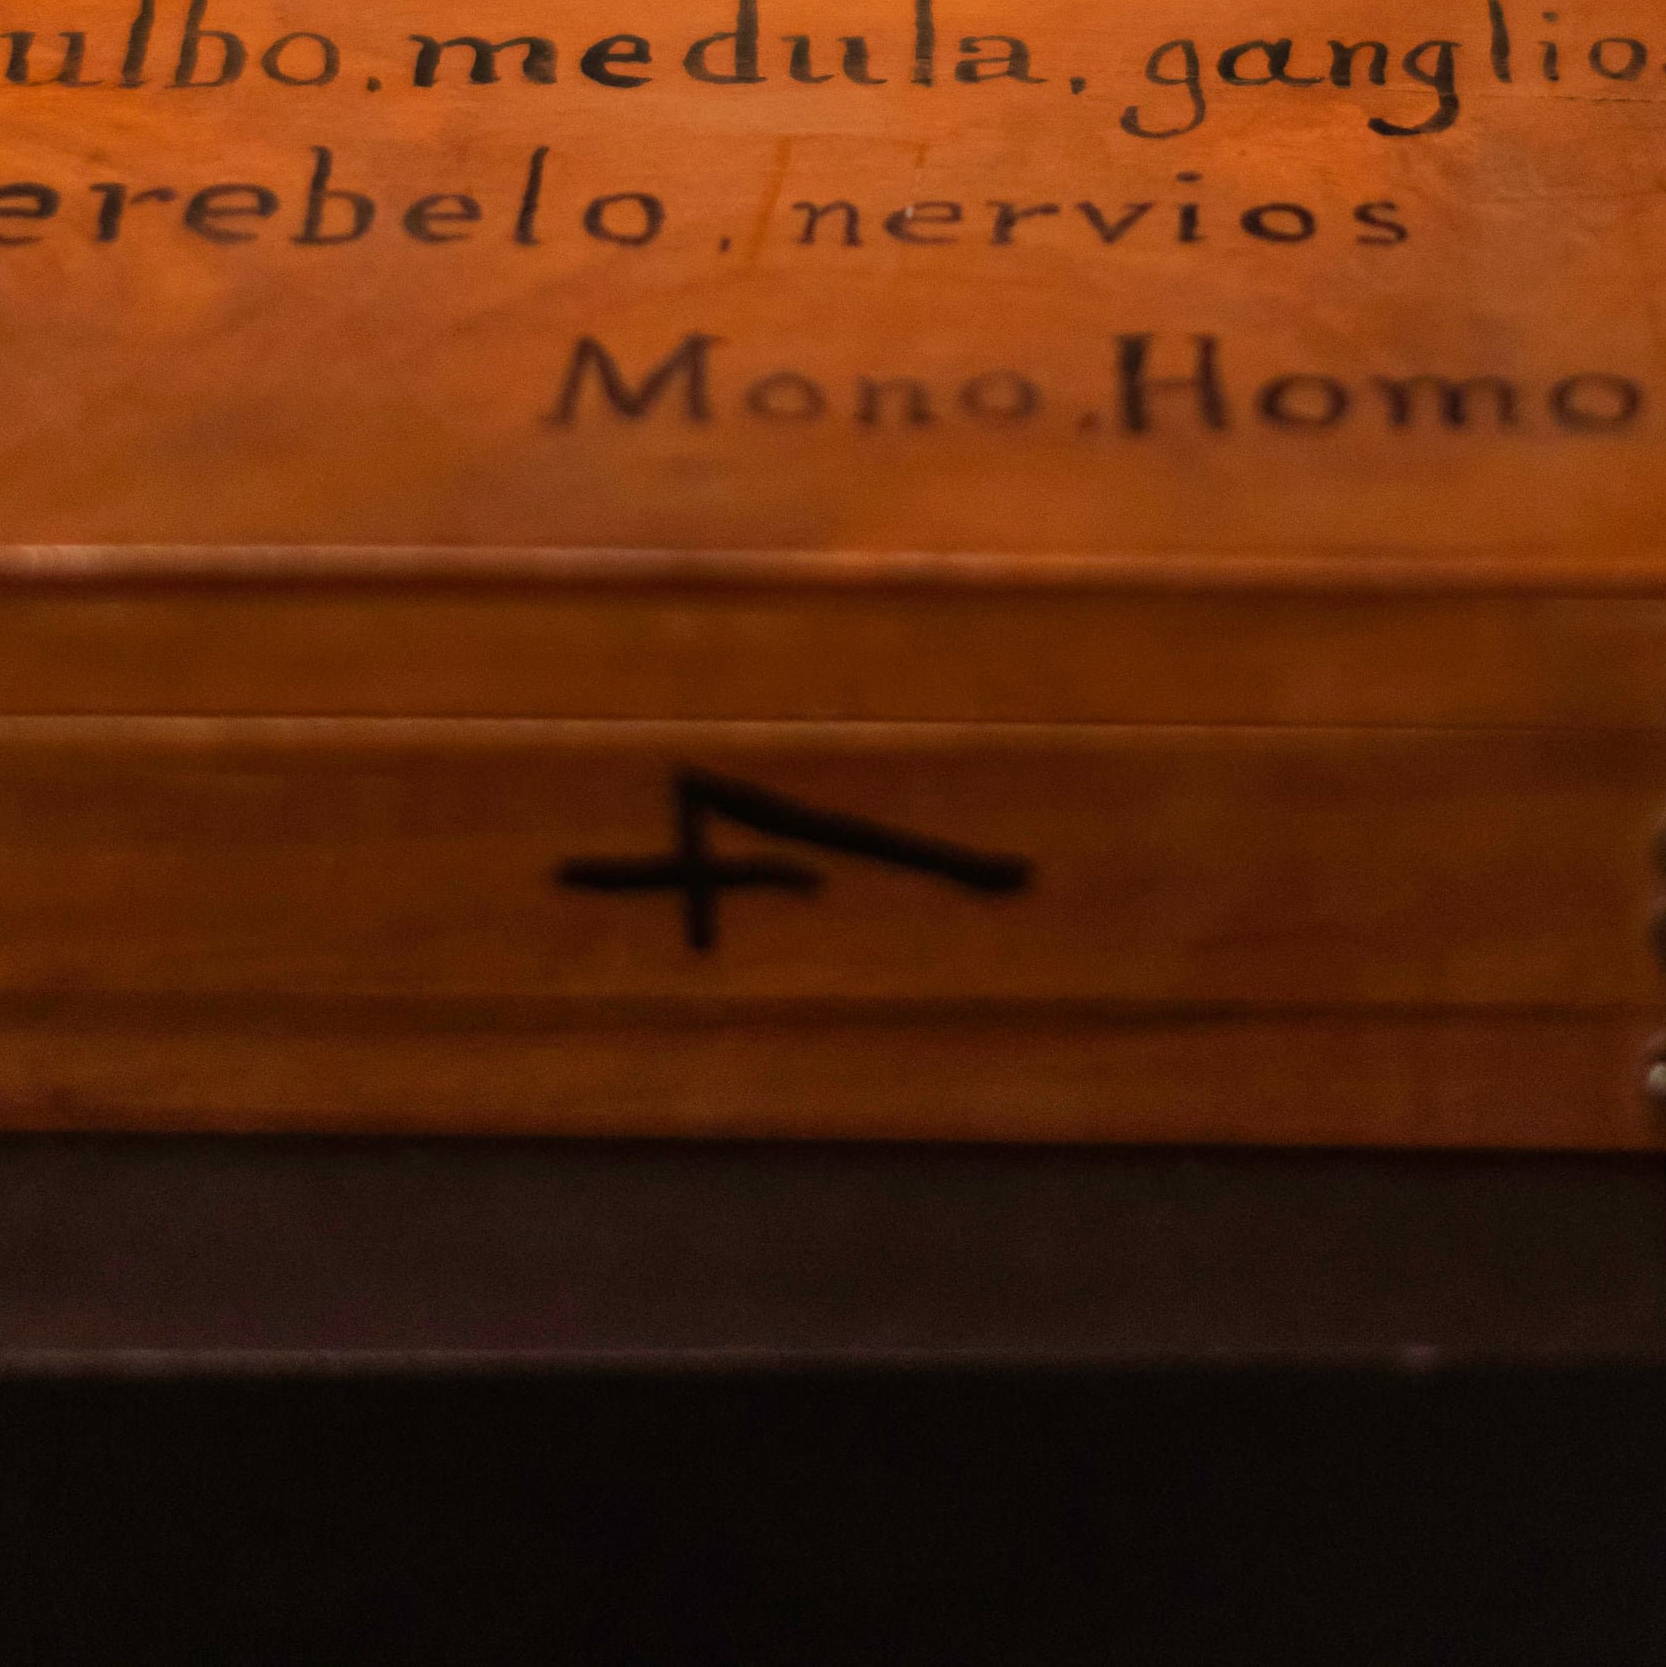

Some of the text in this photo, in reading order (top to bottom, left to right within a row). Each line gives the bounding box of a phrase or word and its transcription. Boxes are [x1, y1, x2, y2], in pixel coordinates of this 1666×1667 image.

[789, 171, 1411, 248] nervios
[1113, 332, 1647, 438] Homo
[555, 760, 1035, 954] 4
